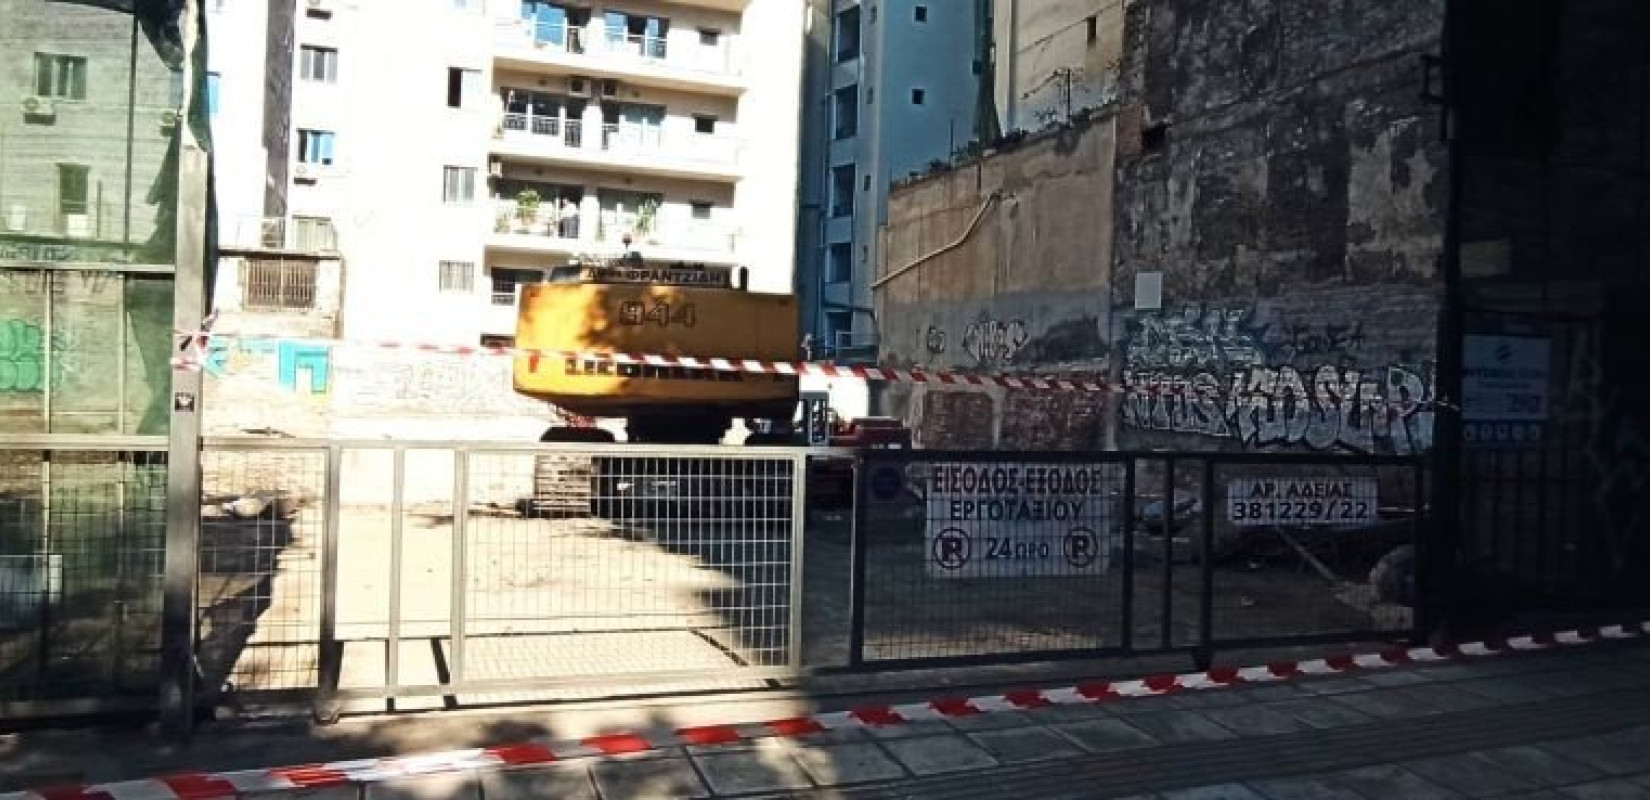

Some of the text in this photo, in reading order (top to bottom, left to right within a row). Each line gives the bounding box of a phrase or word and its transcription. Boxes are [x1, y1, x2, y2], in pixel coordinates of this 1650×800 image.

[932, 466, 1101, 494] ΕΙΣΟΔΟΣ-ΕΞΟΔΟΣ
[1287, 482, 1353, 499] ΑΔΕΙΑΣ
[951, 500, 1083, 521] ΕΡΓΟΤΑΞΙΟΥ
[1233, 501, 1368, 520] 381229/22
